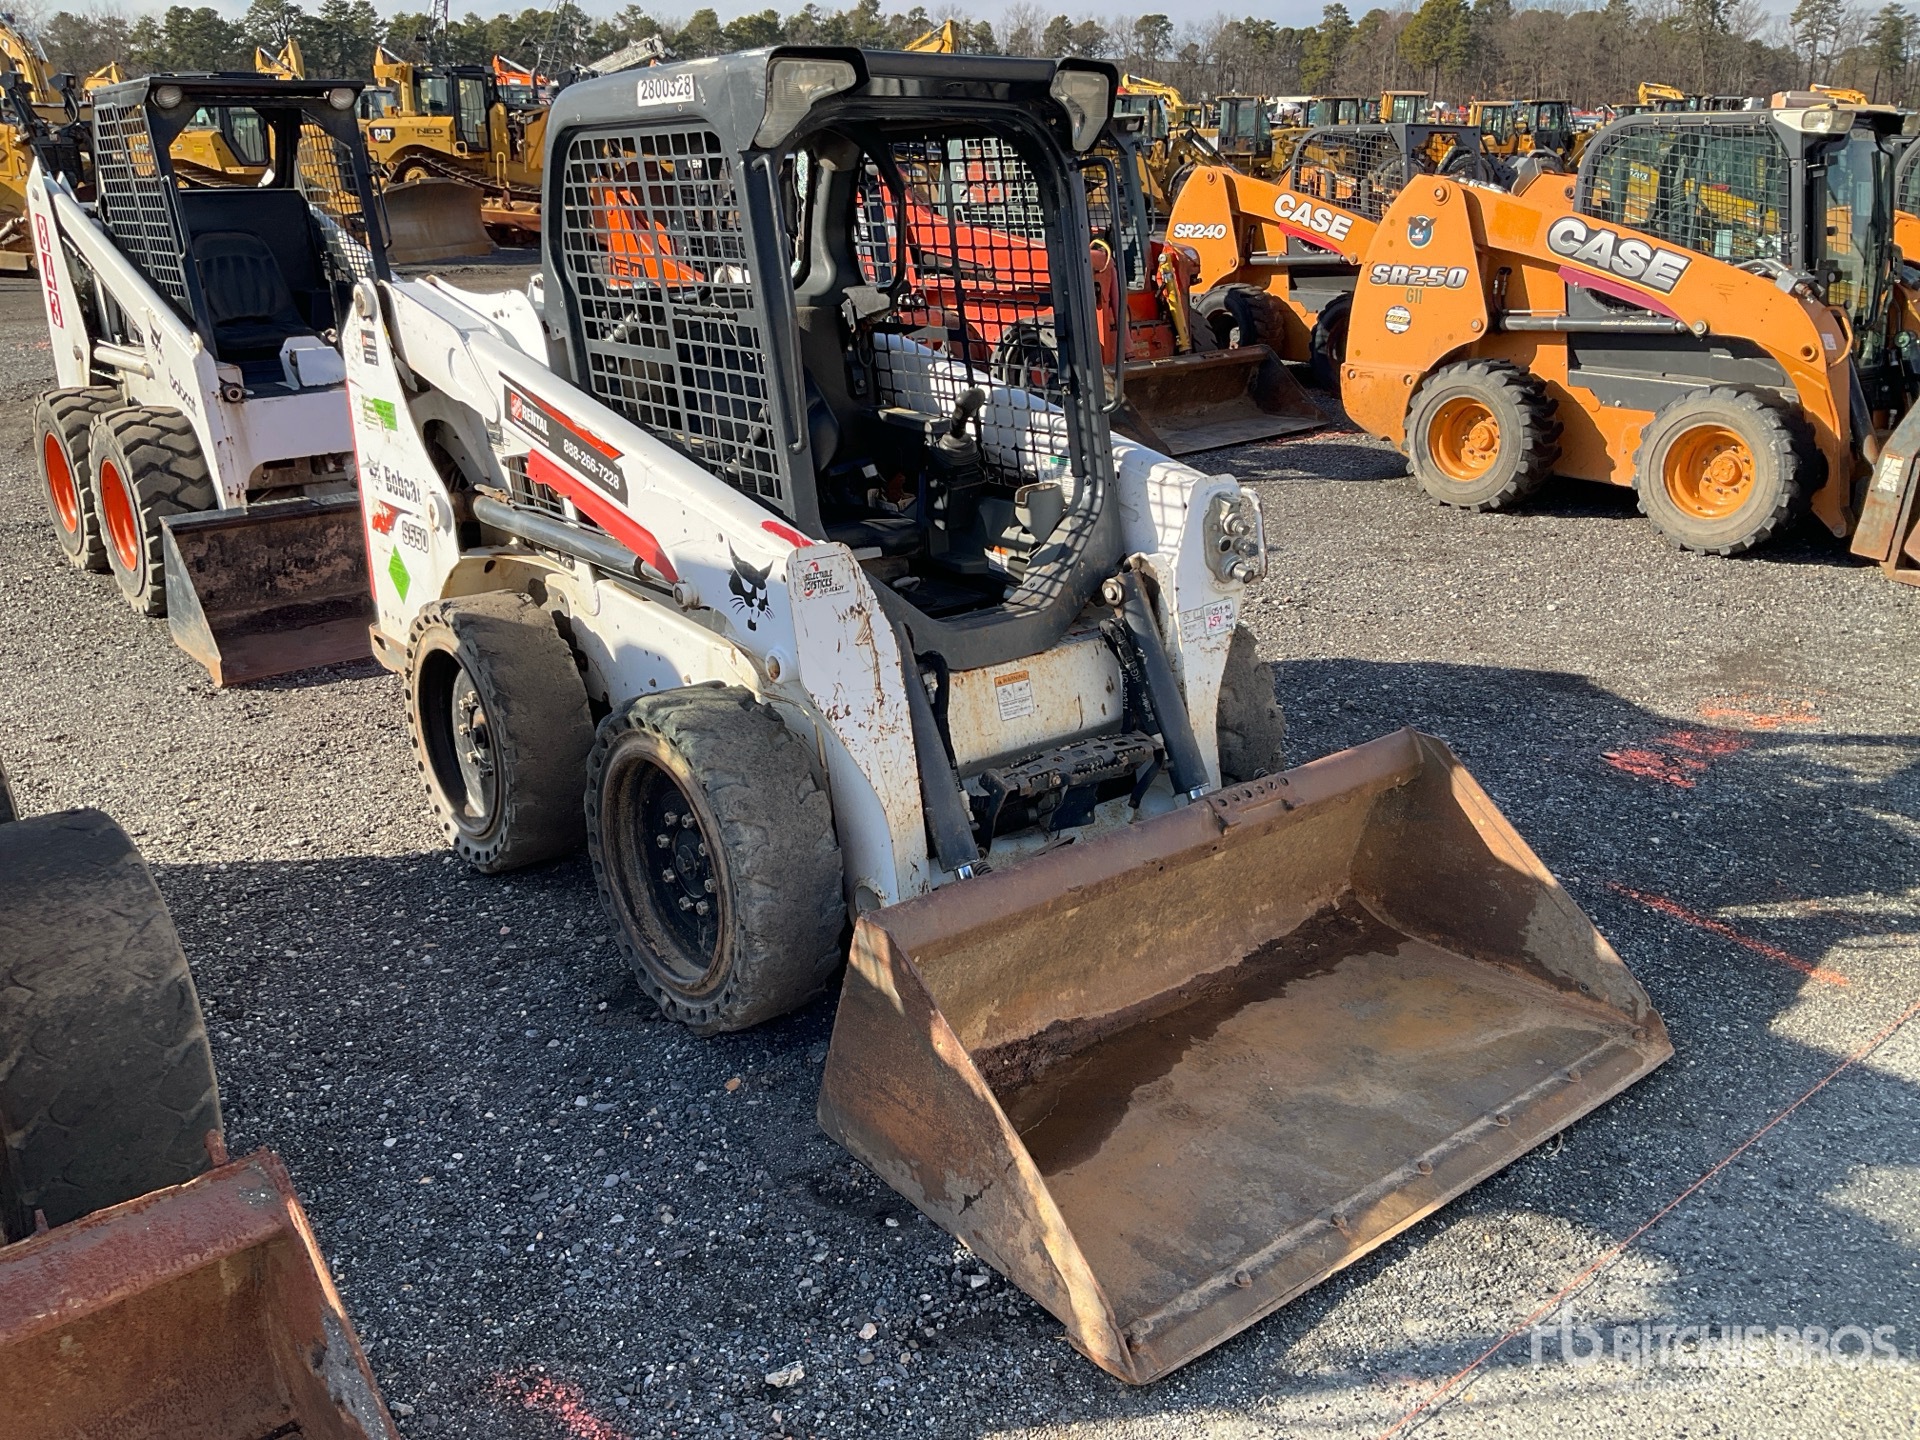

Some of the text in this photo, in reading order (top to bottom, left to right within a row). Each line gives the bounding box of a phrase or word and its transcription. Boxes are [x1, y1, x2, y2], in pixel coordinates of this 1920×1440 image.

[641, 75, 691, 100] 2800328
[374, 129, 392, 141] CAT
[1173, 224, 1227, 239] SR240
[1275, 193, 1354, 241] CASE
[35, 213, 64, 329] 843
[1547, 217, 1692, 293] CASE
[1370, 264, 1469, 289] SR250
[522, 404, 550, 437] RENTAL
[563, 438, 620, 490] 888-266-7228
[384, 465, 422, 505] Bobcat
[402, 520, 430, 554] S550
[804, 577, 833, 591] JOYSTICKS
